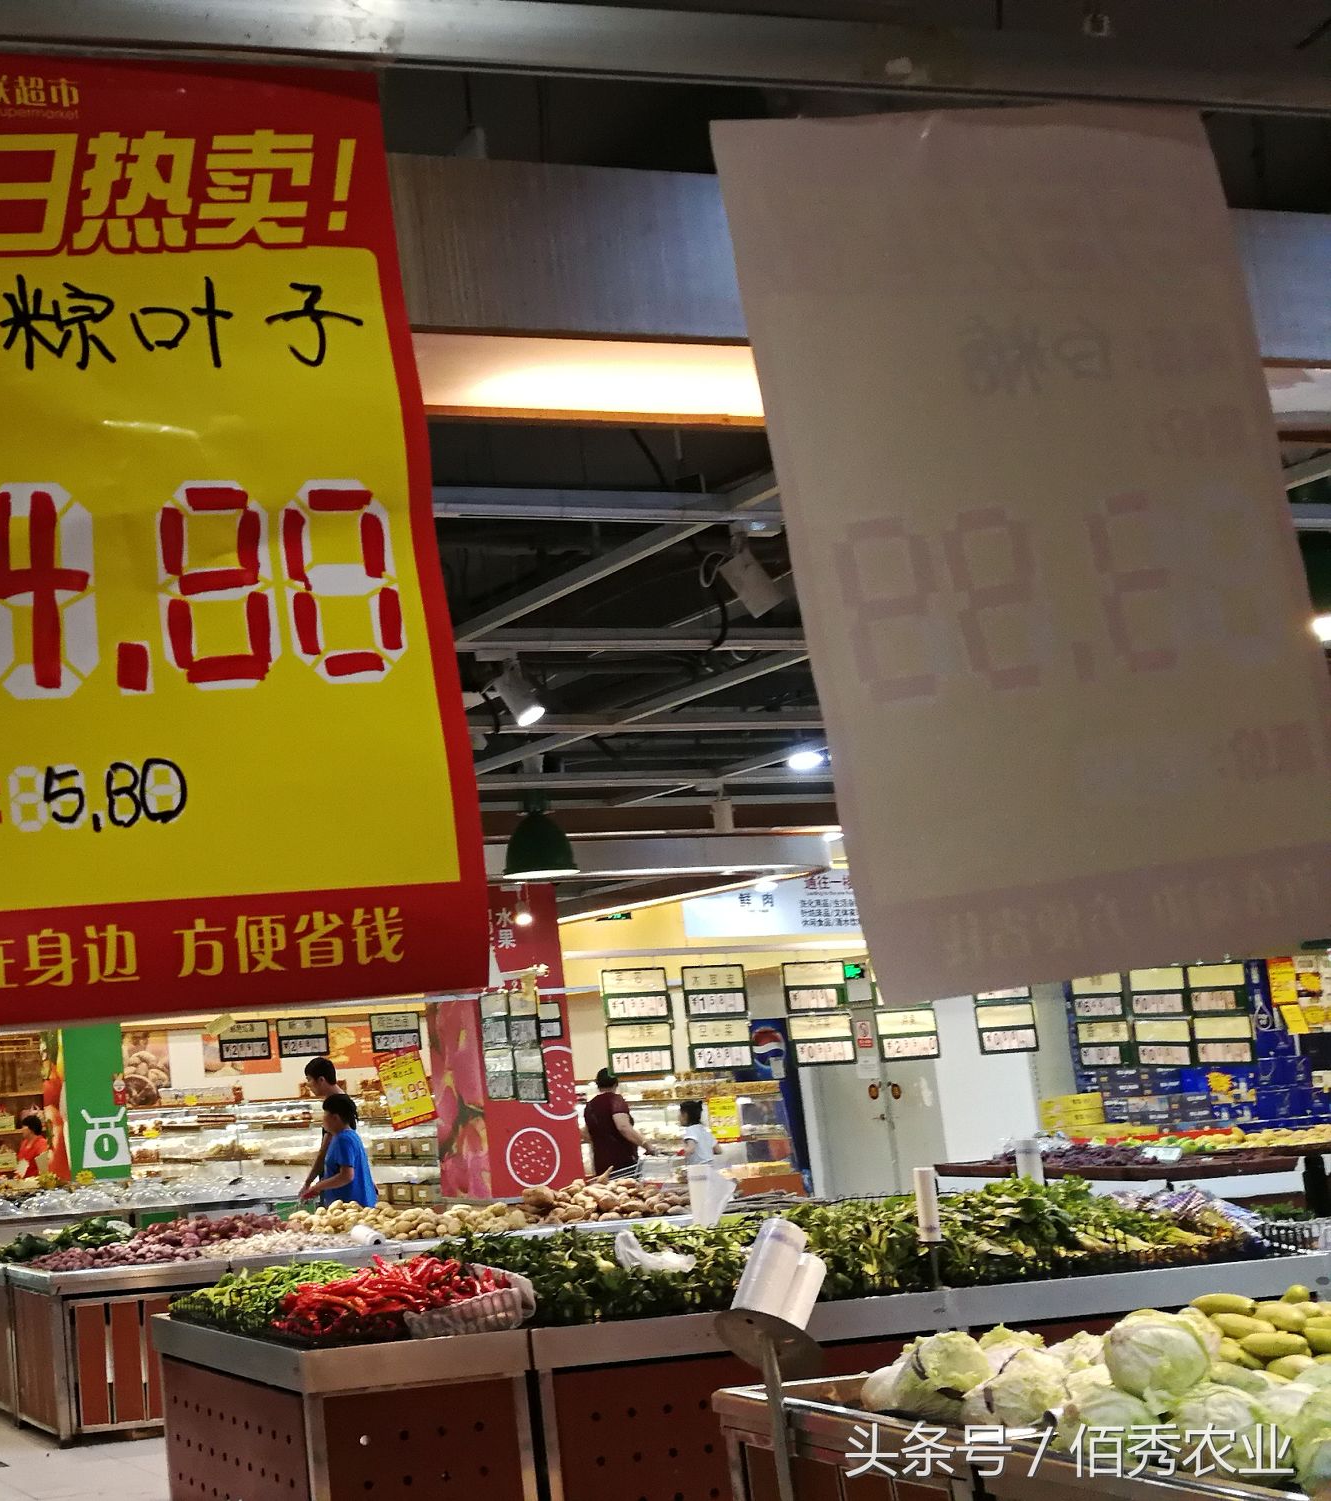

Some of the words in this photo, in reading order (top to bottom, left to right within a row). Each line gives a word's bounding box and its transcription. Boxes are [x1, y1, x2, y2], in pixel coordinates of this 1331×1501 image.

[173, 906, 406, 980] 方便省钱
[495, 907, 517, 950] 水果
